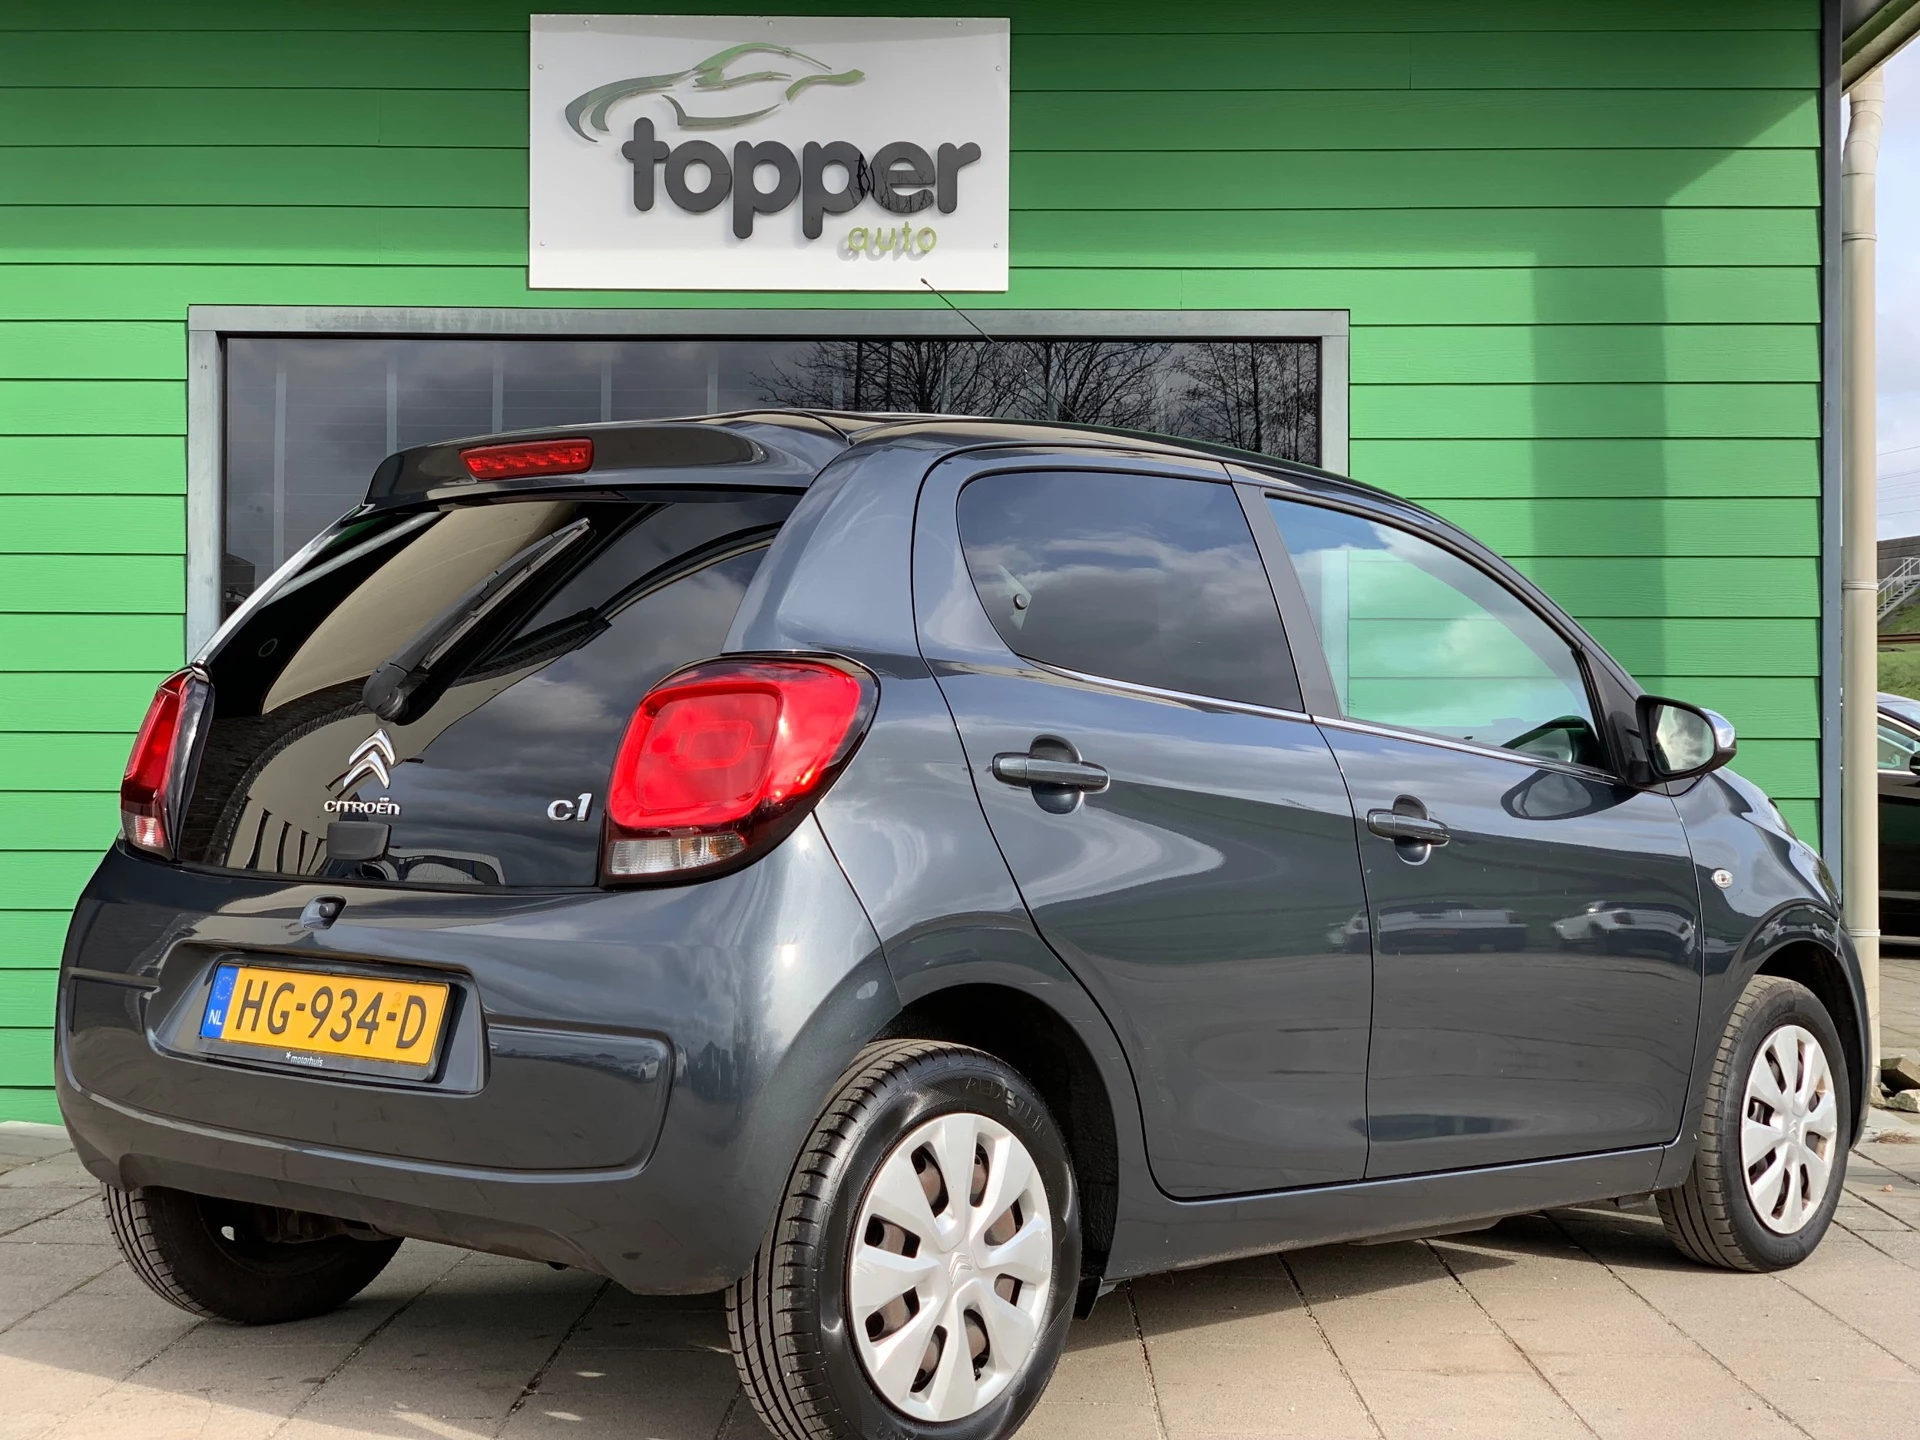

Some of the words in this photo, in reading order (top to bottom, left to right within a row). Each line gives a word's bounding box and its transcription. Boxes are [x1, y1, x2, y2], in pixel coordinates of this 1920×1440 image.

[621, 117, 982, 240] topper
[847, 221, 938, 252] auto
[207, 1008, 223, 1026] NL
[235, 979, 428, 1050] HG-934-D
